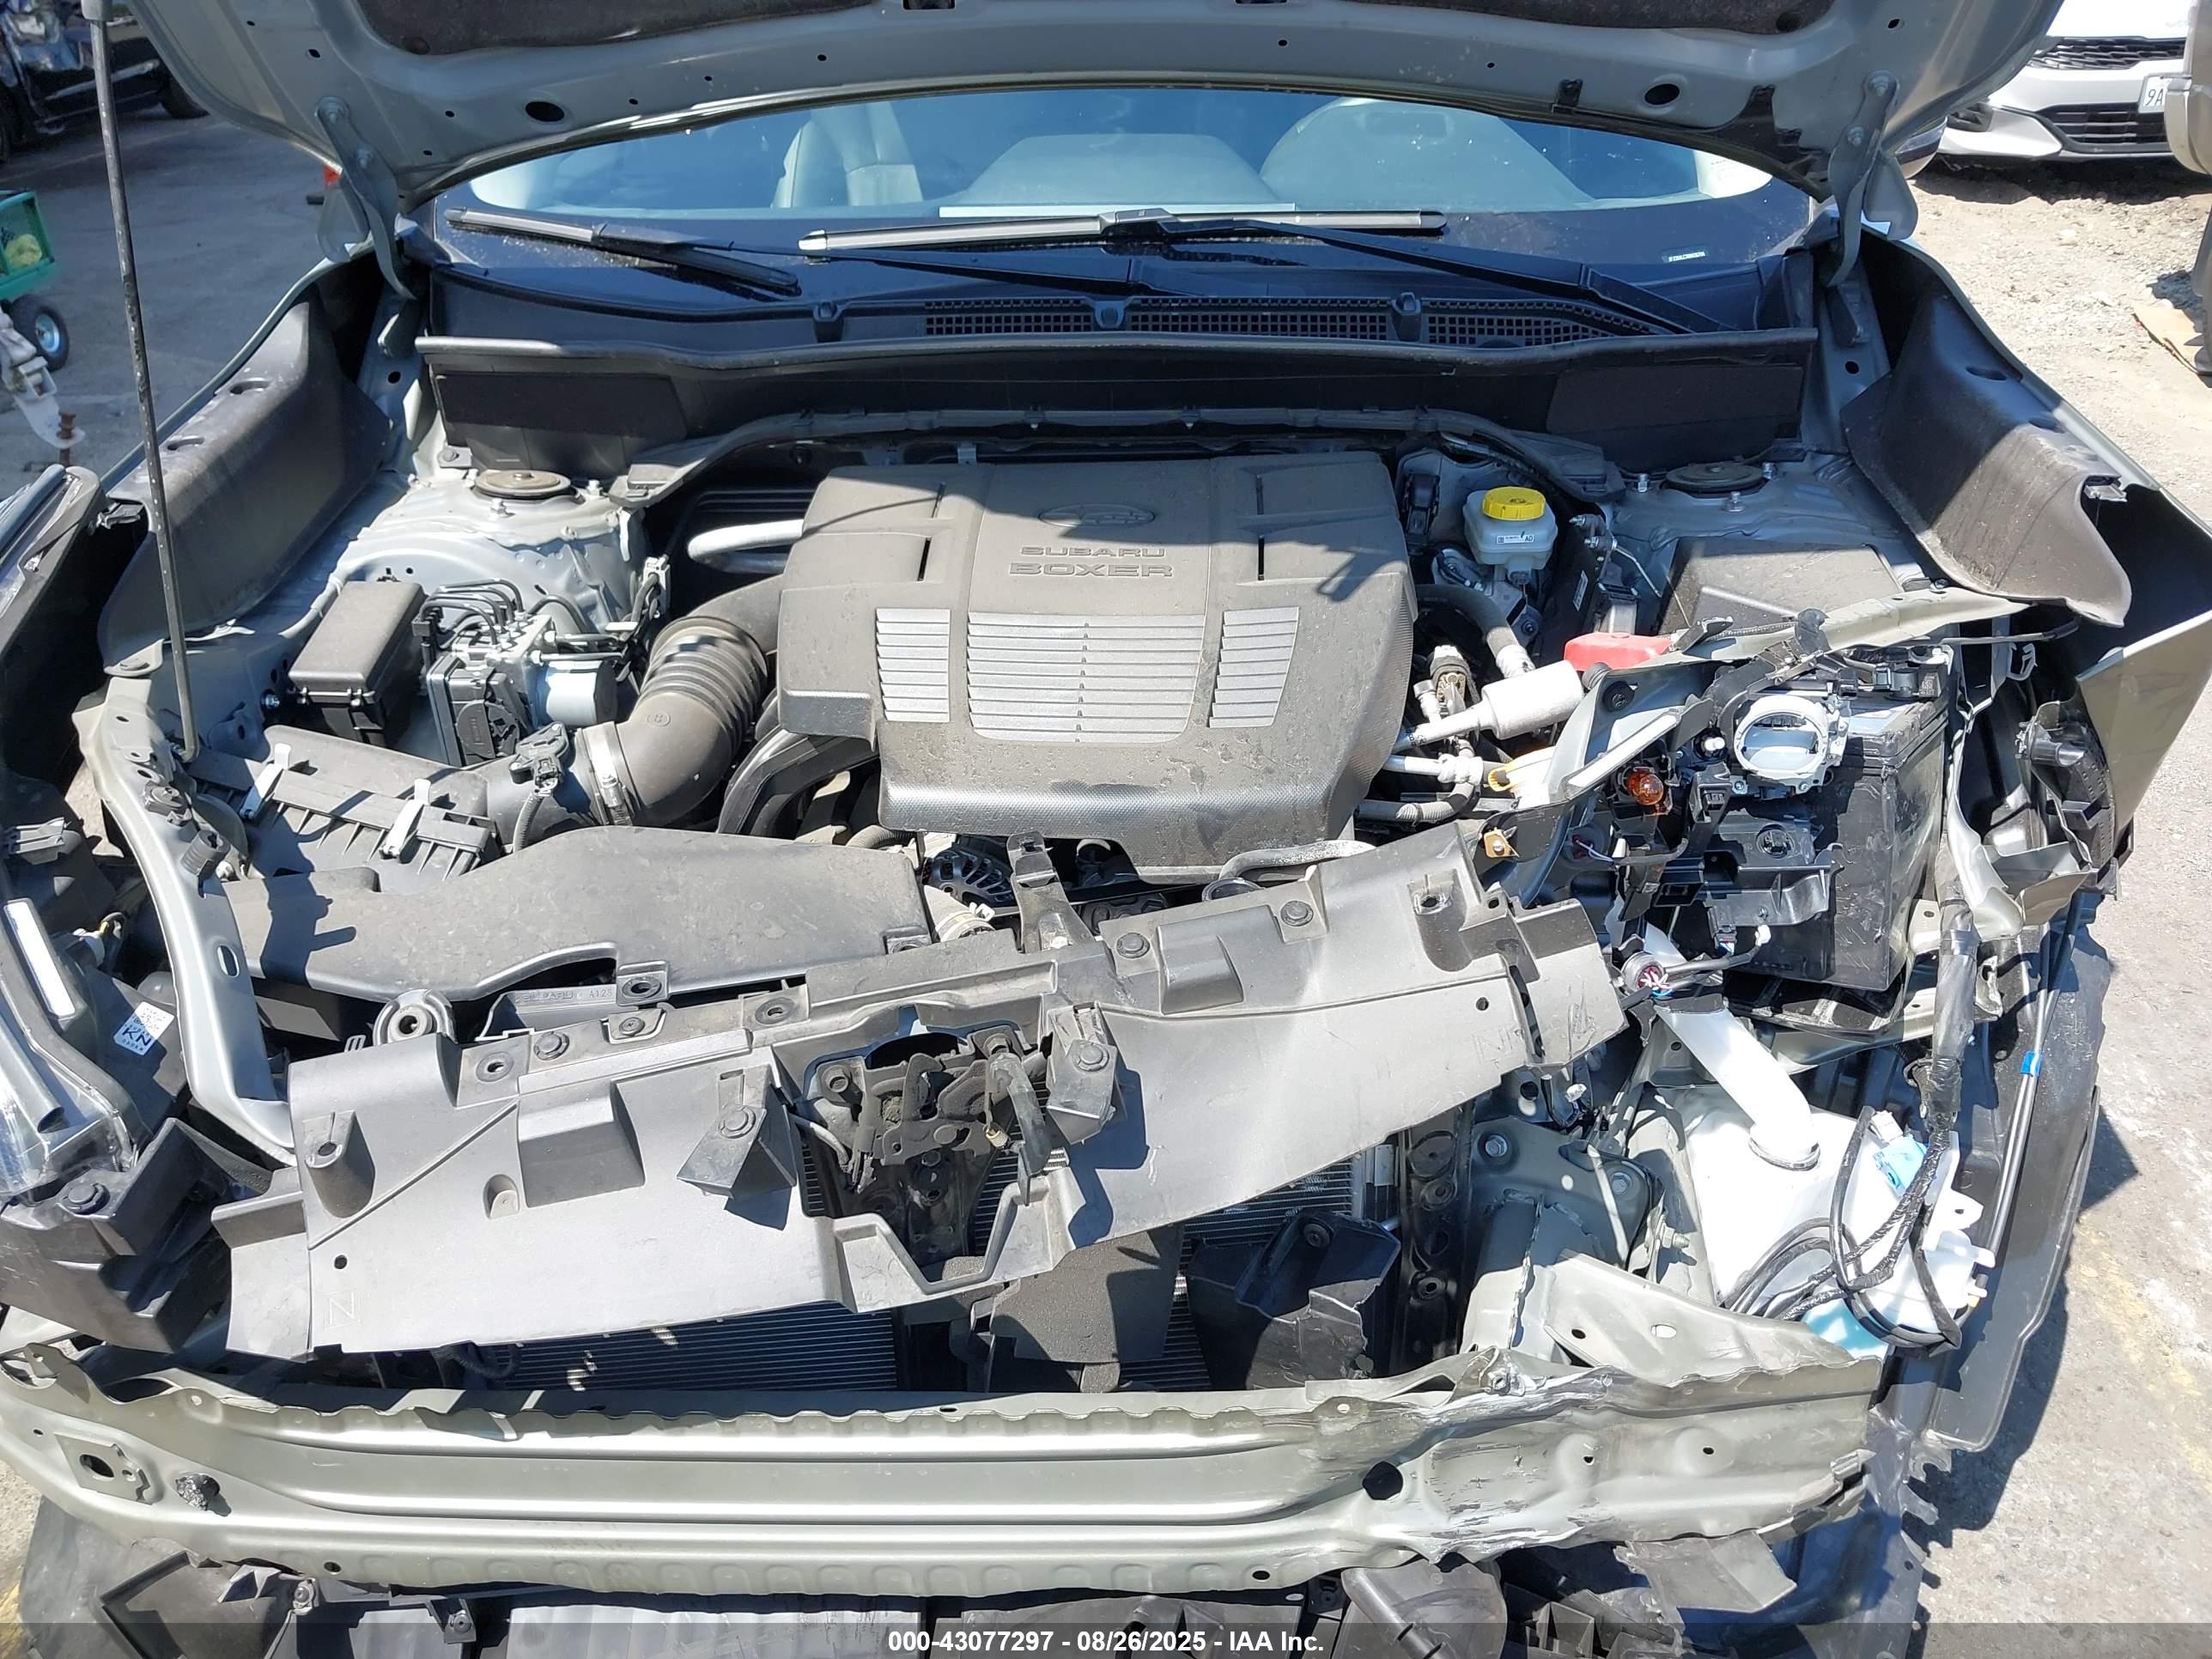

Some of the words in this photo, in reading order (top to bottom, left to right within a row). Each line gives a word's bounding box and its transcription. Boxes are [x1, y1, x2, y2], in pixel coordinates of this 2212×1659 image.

[1021, 546, 1165, 557] SUBARU
[1009, 562, 1173, 577] BOXER
[122, 1027, 152, 1046] KN
